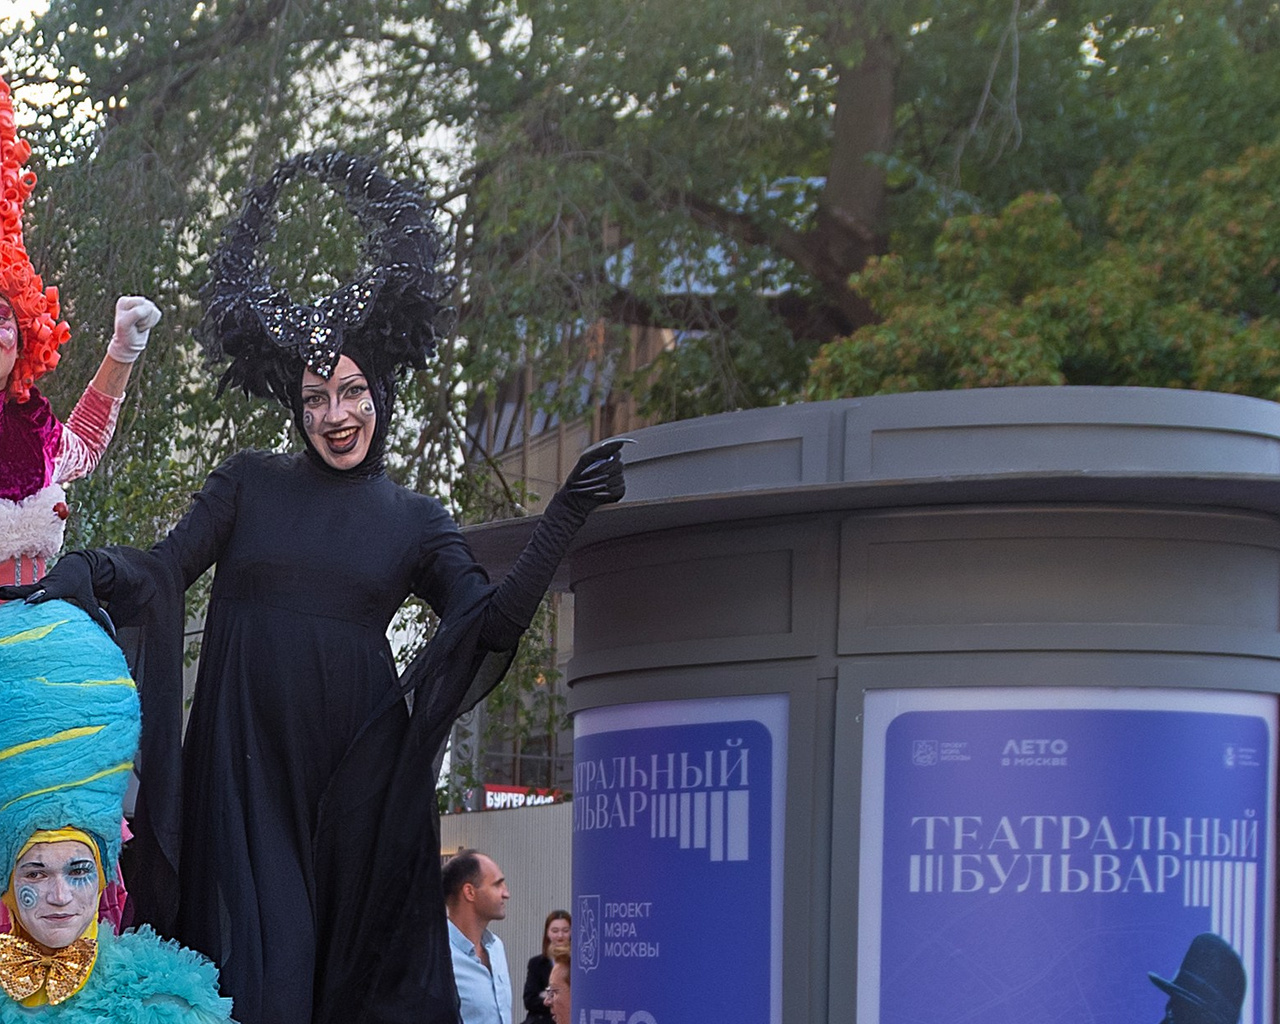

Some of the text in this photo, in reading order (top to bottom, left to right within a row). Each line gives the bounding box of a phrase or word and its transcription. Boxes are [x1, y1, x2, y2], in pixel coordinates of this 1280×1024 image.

[1002, 739, 1068, 755] ЛЕТО
[485, 791, 525, 808] БУРГЕР
[911, 808, 1258, 858] ТЕАТРАЛЬНЫЙ
[951, 854, 1181, 894] БУЛЬВАР
[605, 902, 652, 918] ПРОЕКТ
[604, 922, 637, 937] МЭРА
[604, 942, 659, 957] МОСКВЫ
